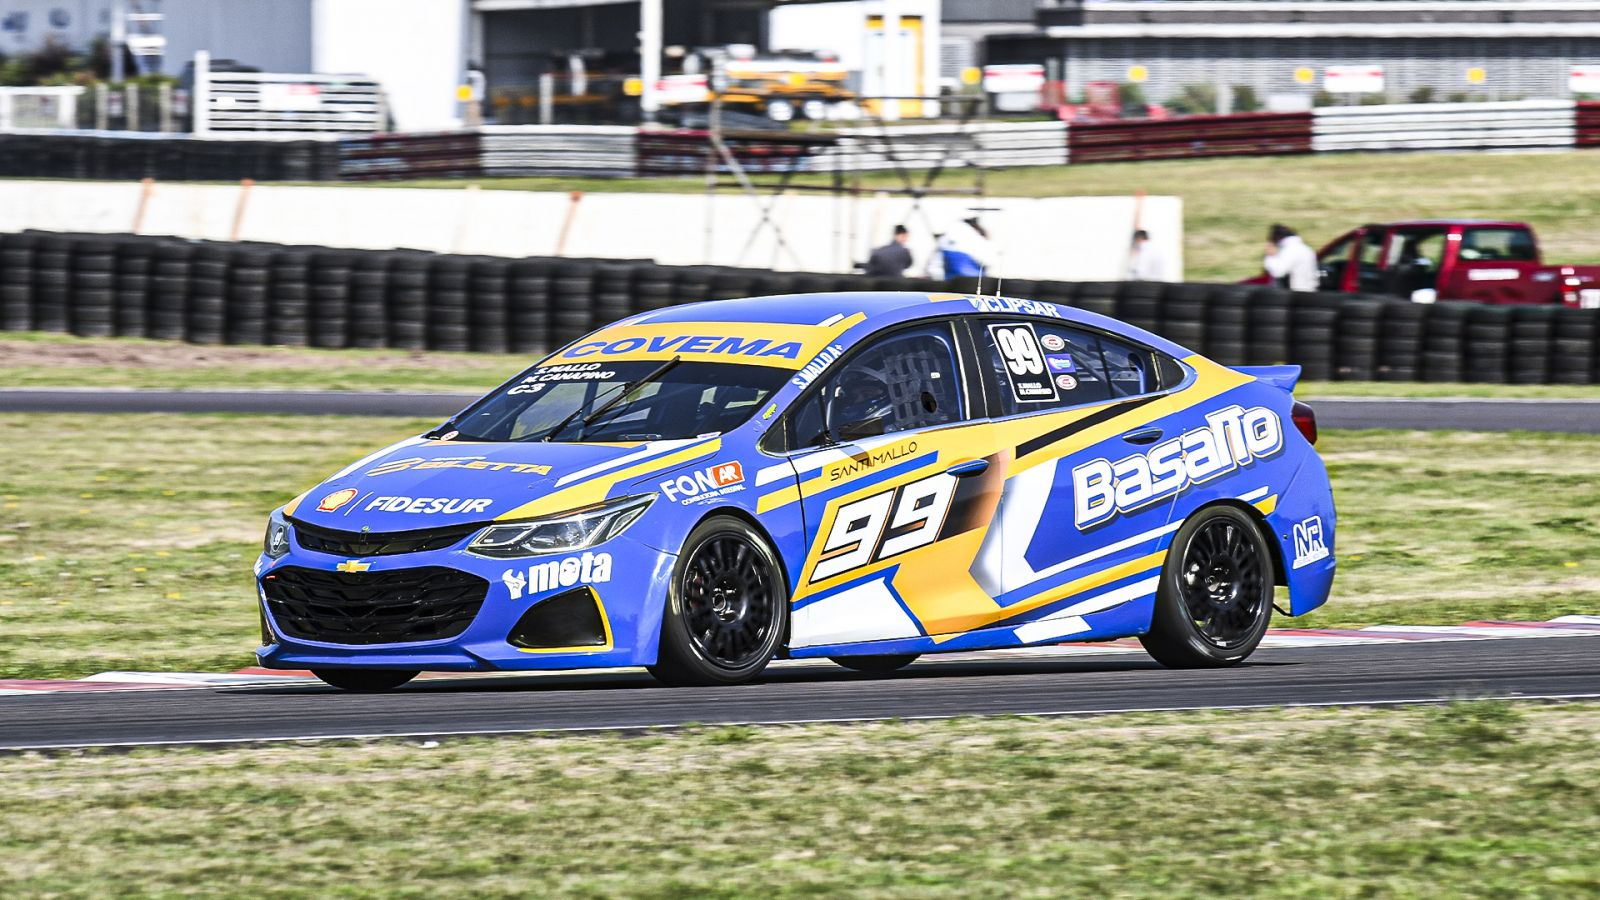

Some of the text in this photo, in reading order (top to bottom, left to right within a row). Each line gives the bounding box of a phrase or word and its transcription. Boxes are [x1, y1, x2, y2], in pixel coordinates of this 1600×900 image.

[984, 298, 1062, 318] CLIPSAR
[562, 336, 803, 359] COVEMA
[997, 328, 1044, 375] 99
[507, 383, 546, 395] C3
[364, 496, 493, 514] FIDESUR
[809, 471, 958, 584] 99
[528, 552, 612, 595] mota
